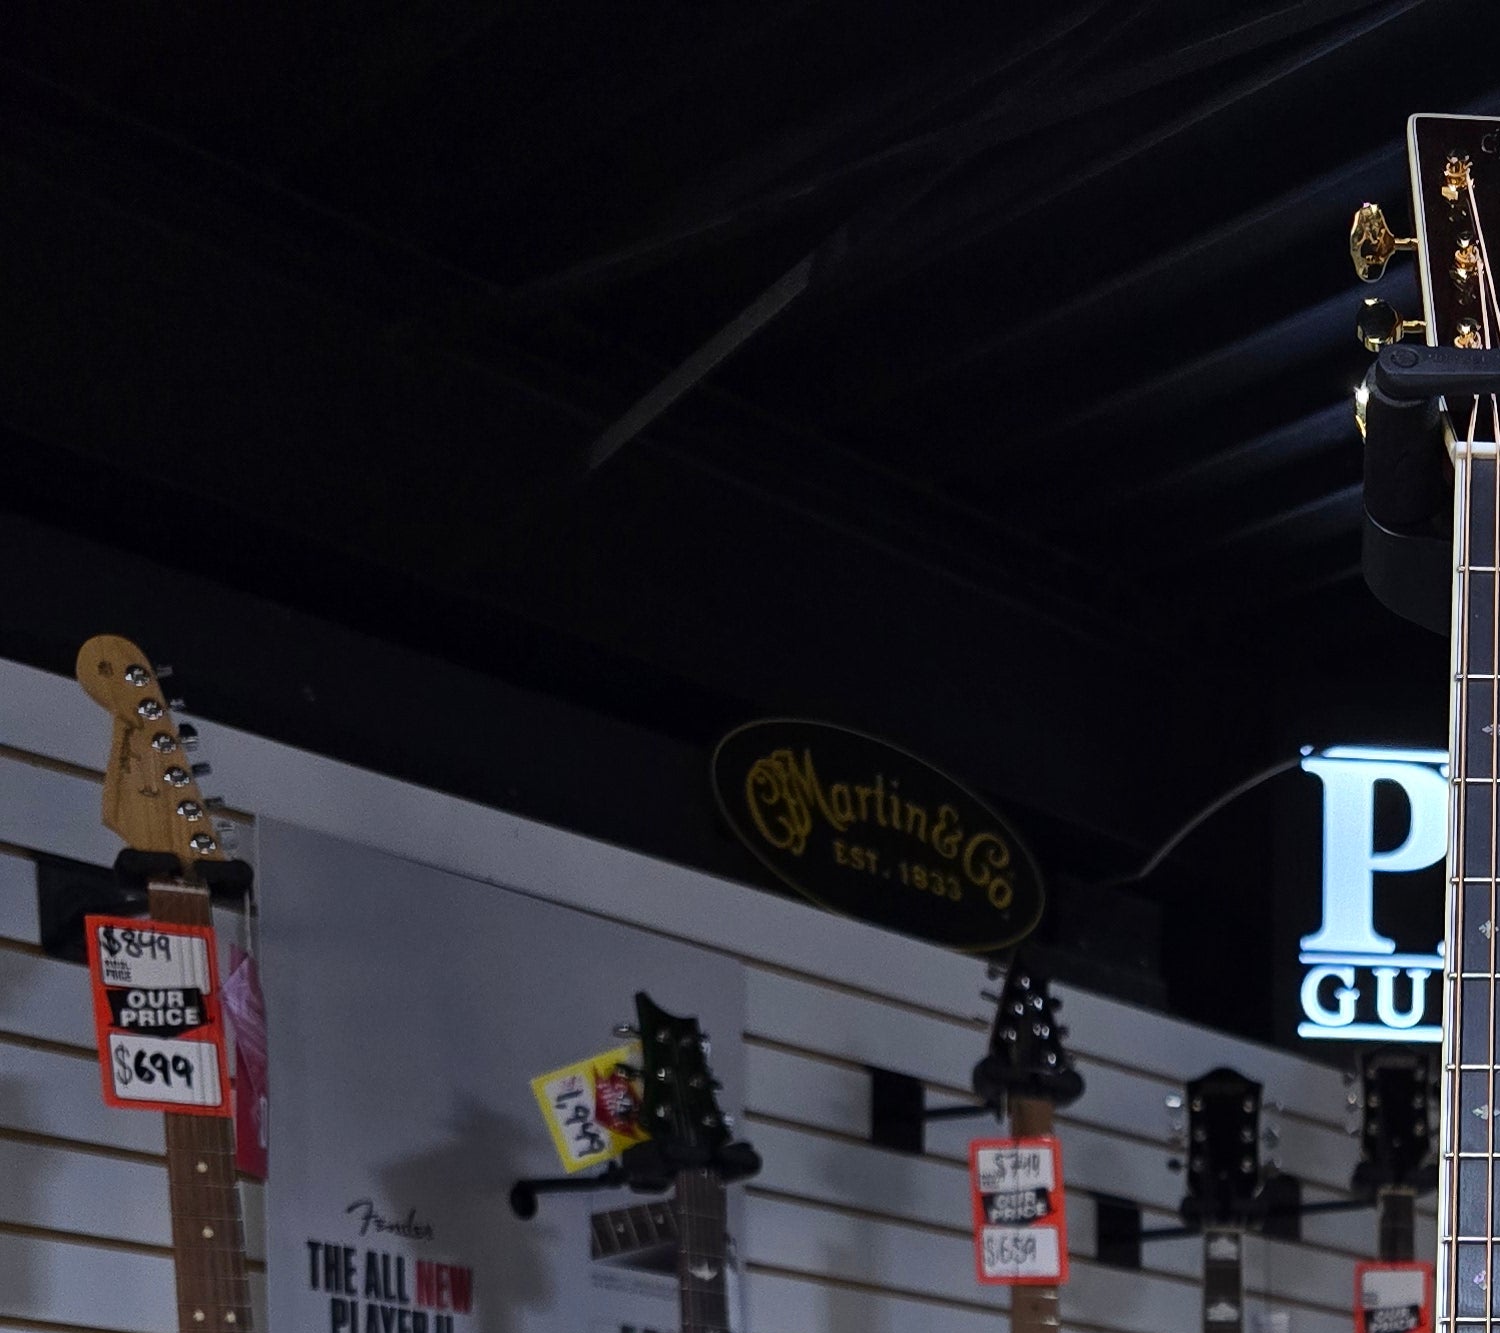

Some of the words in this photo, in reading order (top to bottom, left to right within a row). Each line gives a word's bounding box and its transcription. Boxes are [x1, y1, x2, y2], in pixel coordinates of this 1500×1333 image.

[899, 862, 962, 901] 1833
[120, 1008, 199, 1028] PRICE
[127, 990, 185, 1010] OUR
[114, 1042, 194, 1089] $699
[346, 1200, 435, 1243] Fender
[989, 1202, 1048, 1222] PRICE
[307, 1237, 358, 1297] THE
[364, 1250, 410, 1305] ALL
[416, 1259, 474, 1315] NEW
